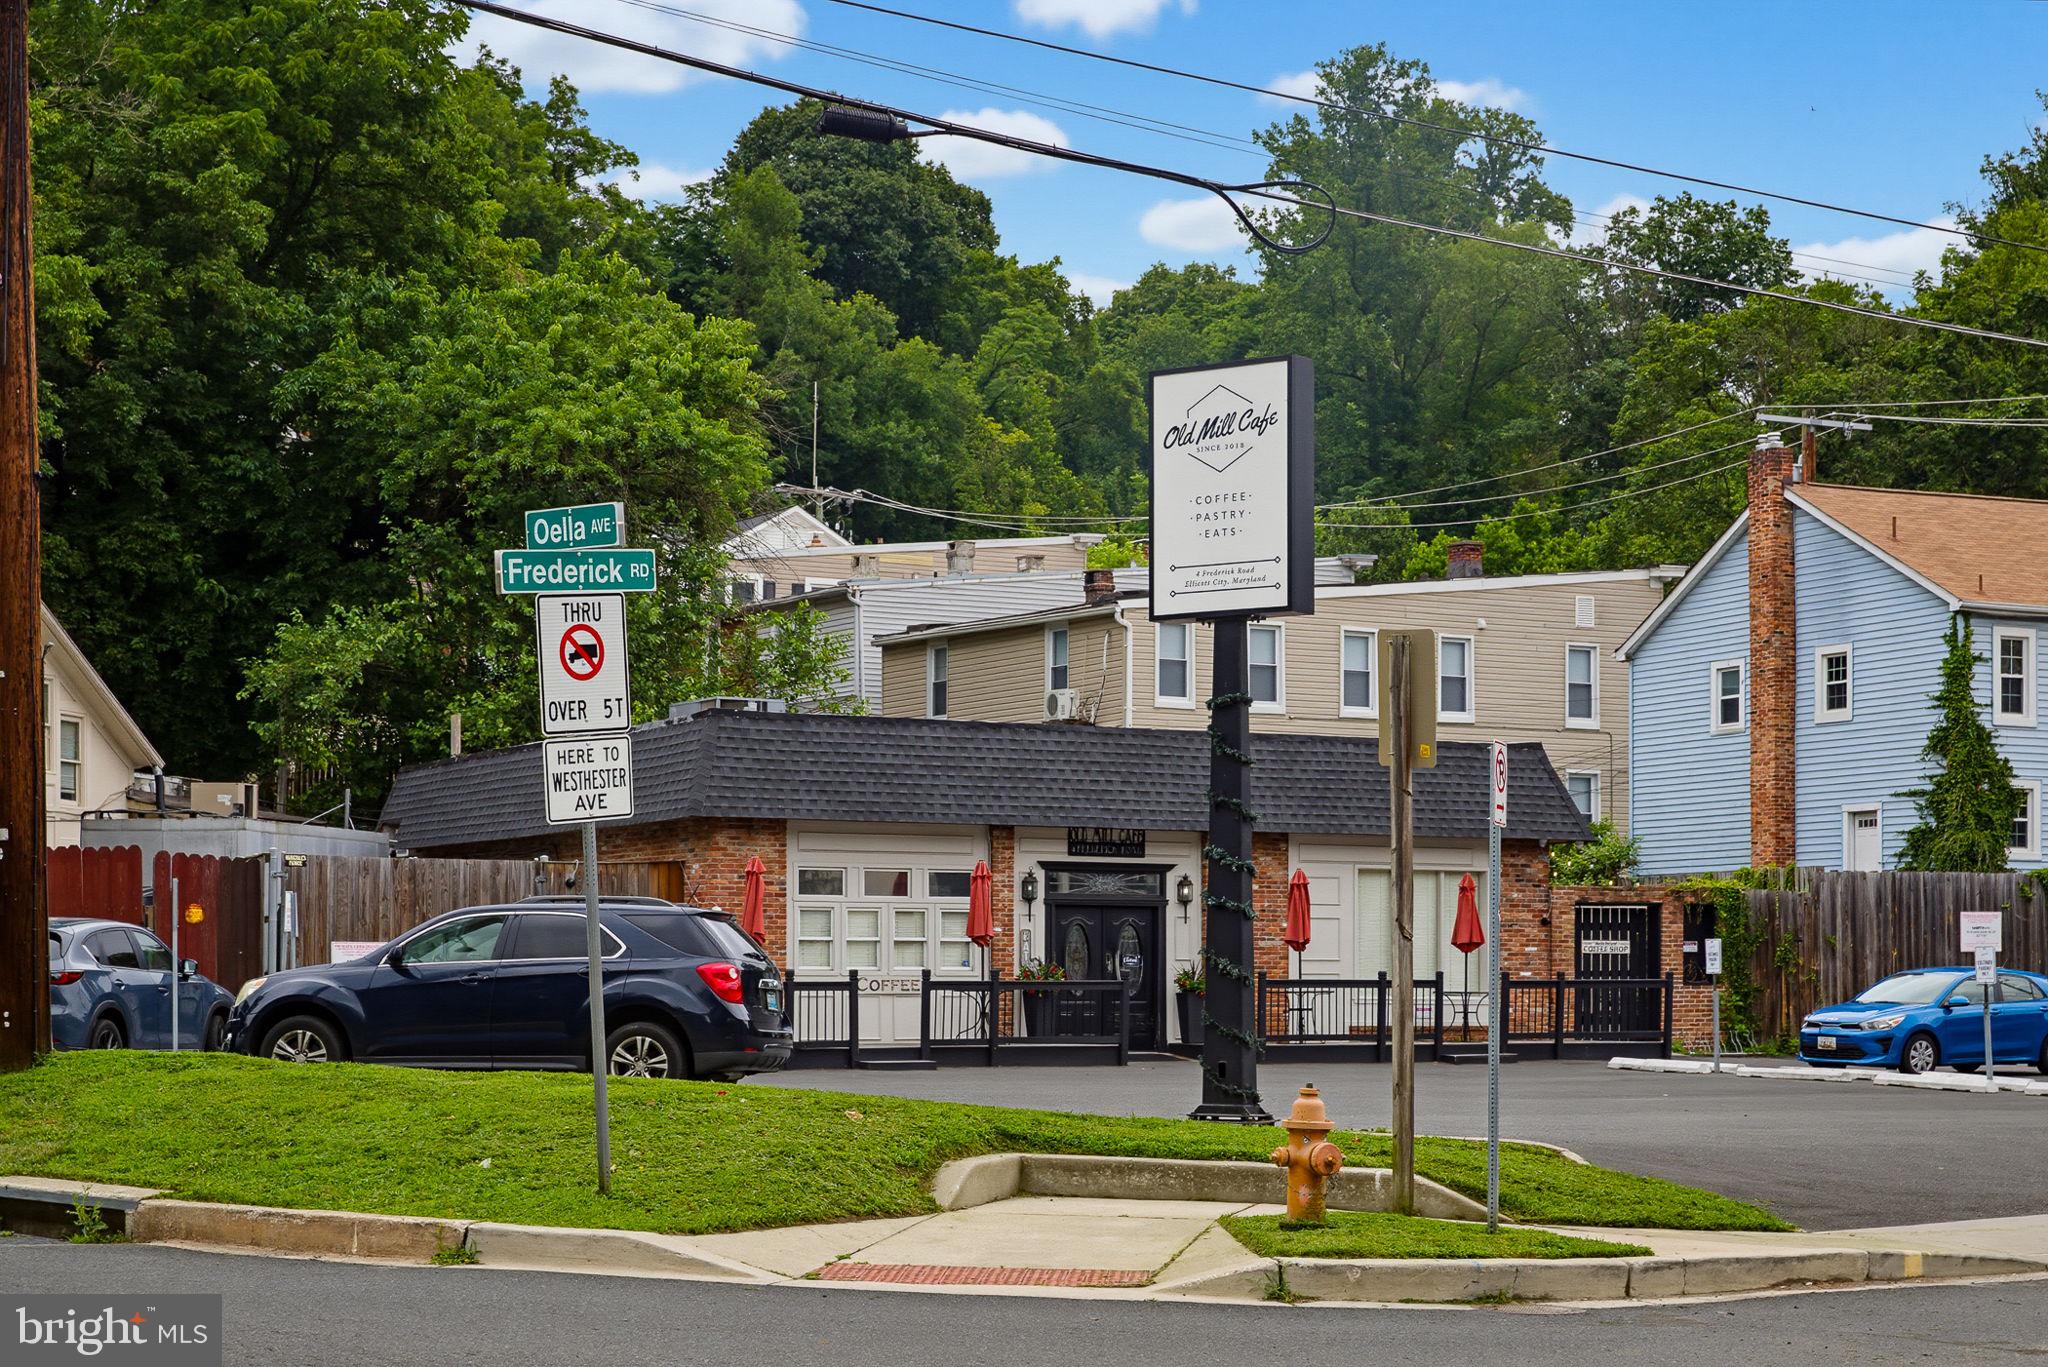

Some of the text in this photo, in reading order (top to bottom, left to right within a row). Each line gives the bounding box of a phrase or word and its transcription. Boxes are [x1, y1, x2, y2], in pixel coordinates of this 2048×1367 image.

[1163, 403, 1279, 449] Old Mill Cafe
[1196, 444, 1222, 453] SINCE
[1195, 491, 1246, 505] COFFEE
[1196, 509, 1245, 522] PASTRY
[533, 516, 612, 545] Oella AVE
[1204, 527, 1236, 539] EATS
[507, 557, 649, 585] Frederick RD
[1201, 567, 1235, 578] Frederick
[1237, 566, 1256, 575] Road
[1232, 575, 1267, 585] Maryland
[561, 602, 602, 623] THRU
[549, 700, 588, 722] OVER
[557, 746, 620, 765] HERE TO
[552, 767, 627, 793] WESTHESTER
[575, 793, 608, 812] AVE
[1609, 945, 1629, 953] SHOP
[857, 977, 921, 992] COFFEE
